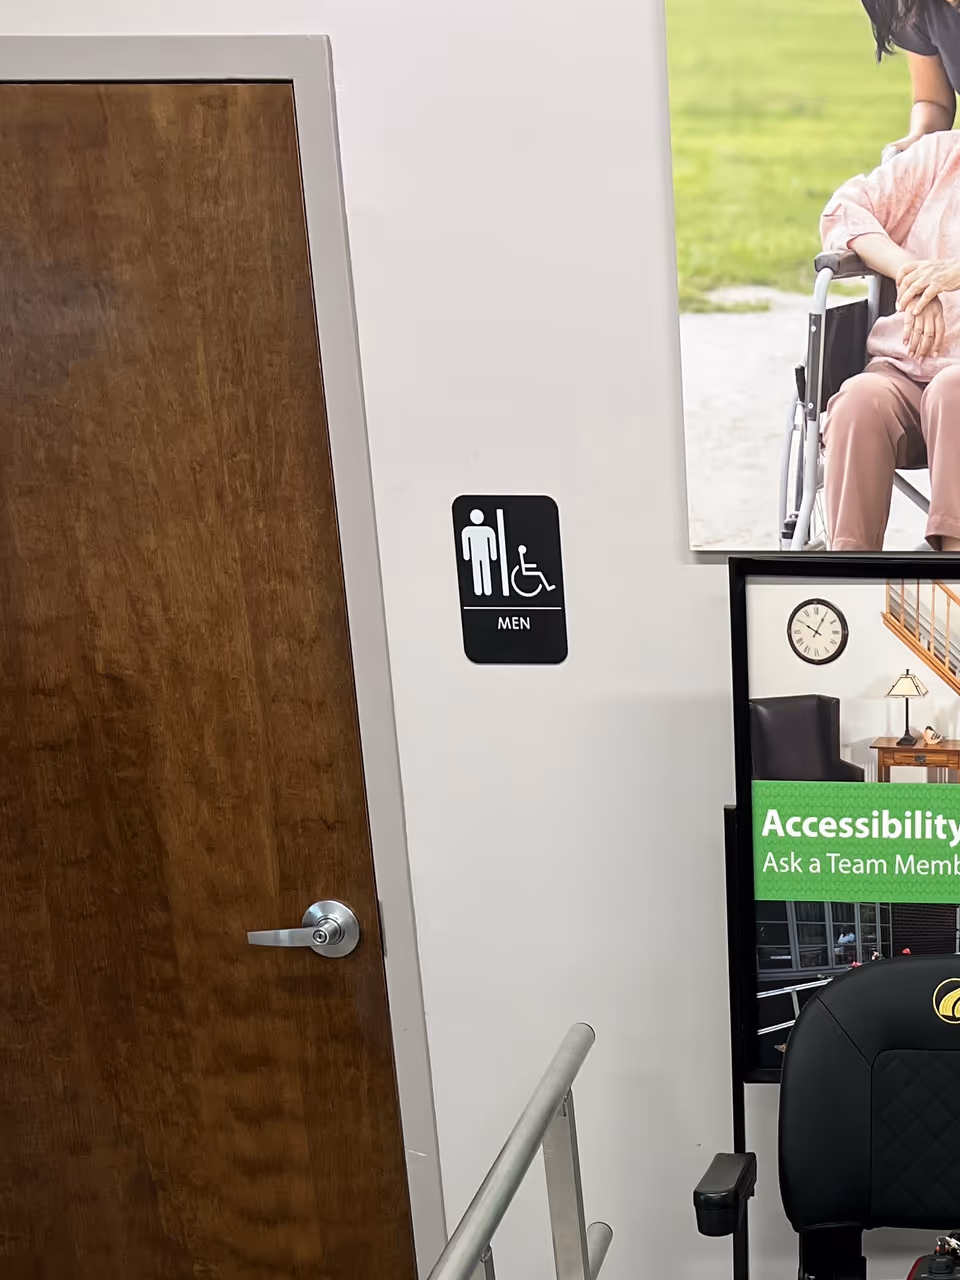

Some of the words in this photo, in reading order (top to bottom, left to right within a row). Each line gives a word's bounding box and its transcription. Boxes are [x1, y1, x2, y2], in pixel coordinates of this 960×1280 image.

[497, 616, 531, 630] MEN
[762, 851, 803, 873] Ask
[808, 858, 821, 874] a
[825, 852, 887, 875] Team
